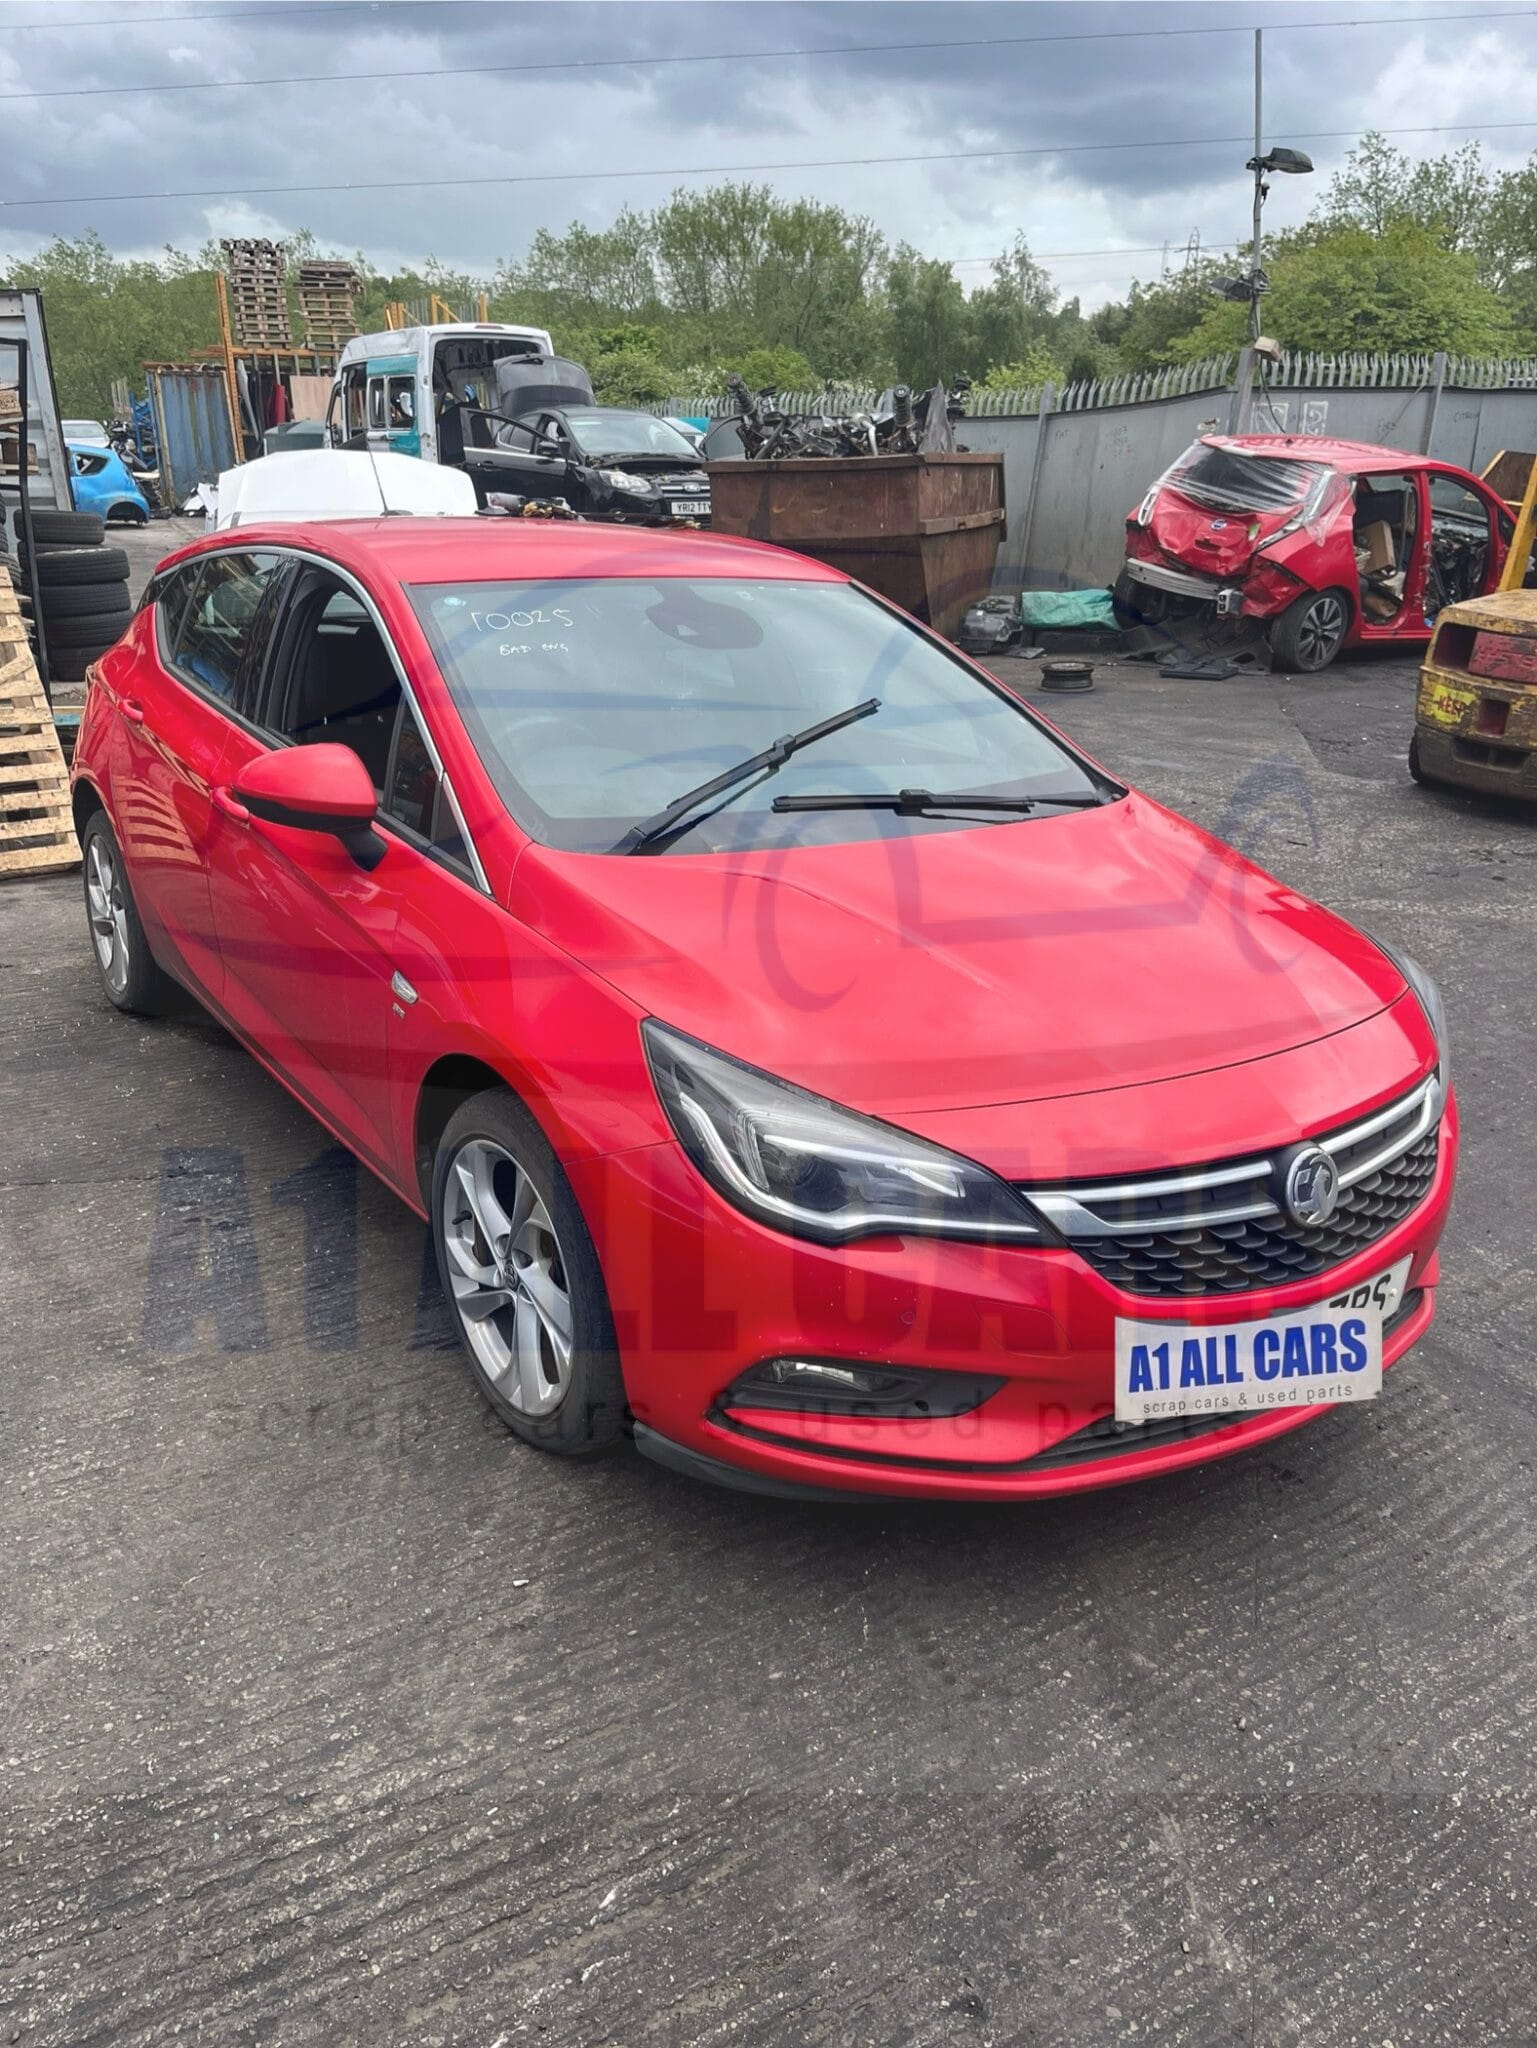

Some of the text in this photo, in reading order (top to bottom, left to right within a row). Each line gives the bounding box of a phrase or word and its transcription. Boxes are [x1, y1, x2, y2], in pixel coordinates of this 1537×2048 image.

[677, 503, 695, 513] YR12
[1179, 1334, 1244, 1388] ALL
[1253, 1318, 1367, 1381] CARS
[1143, 1383, 1353, 1414] scrap cars & used parts
